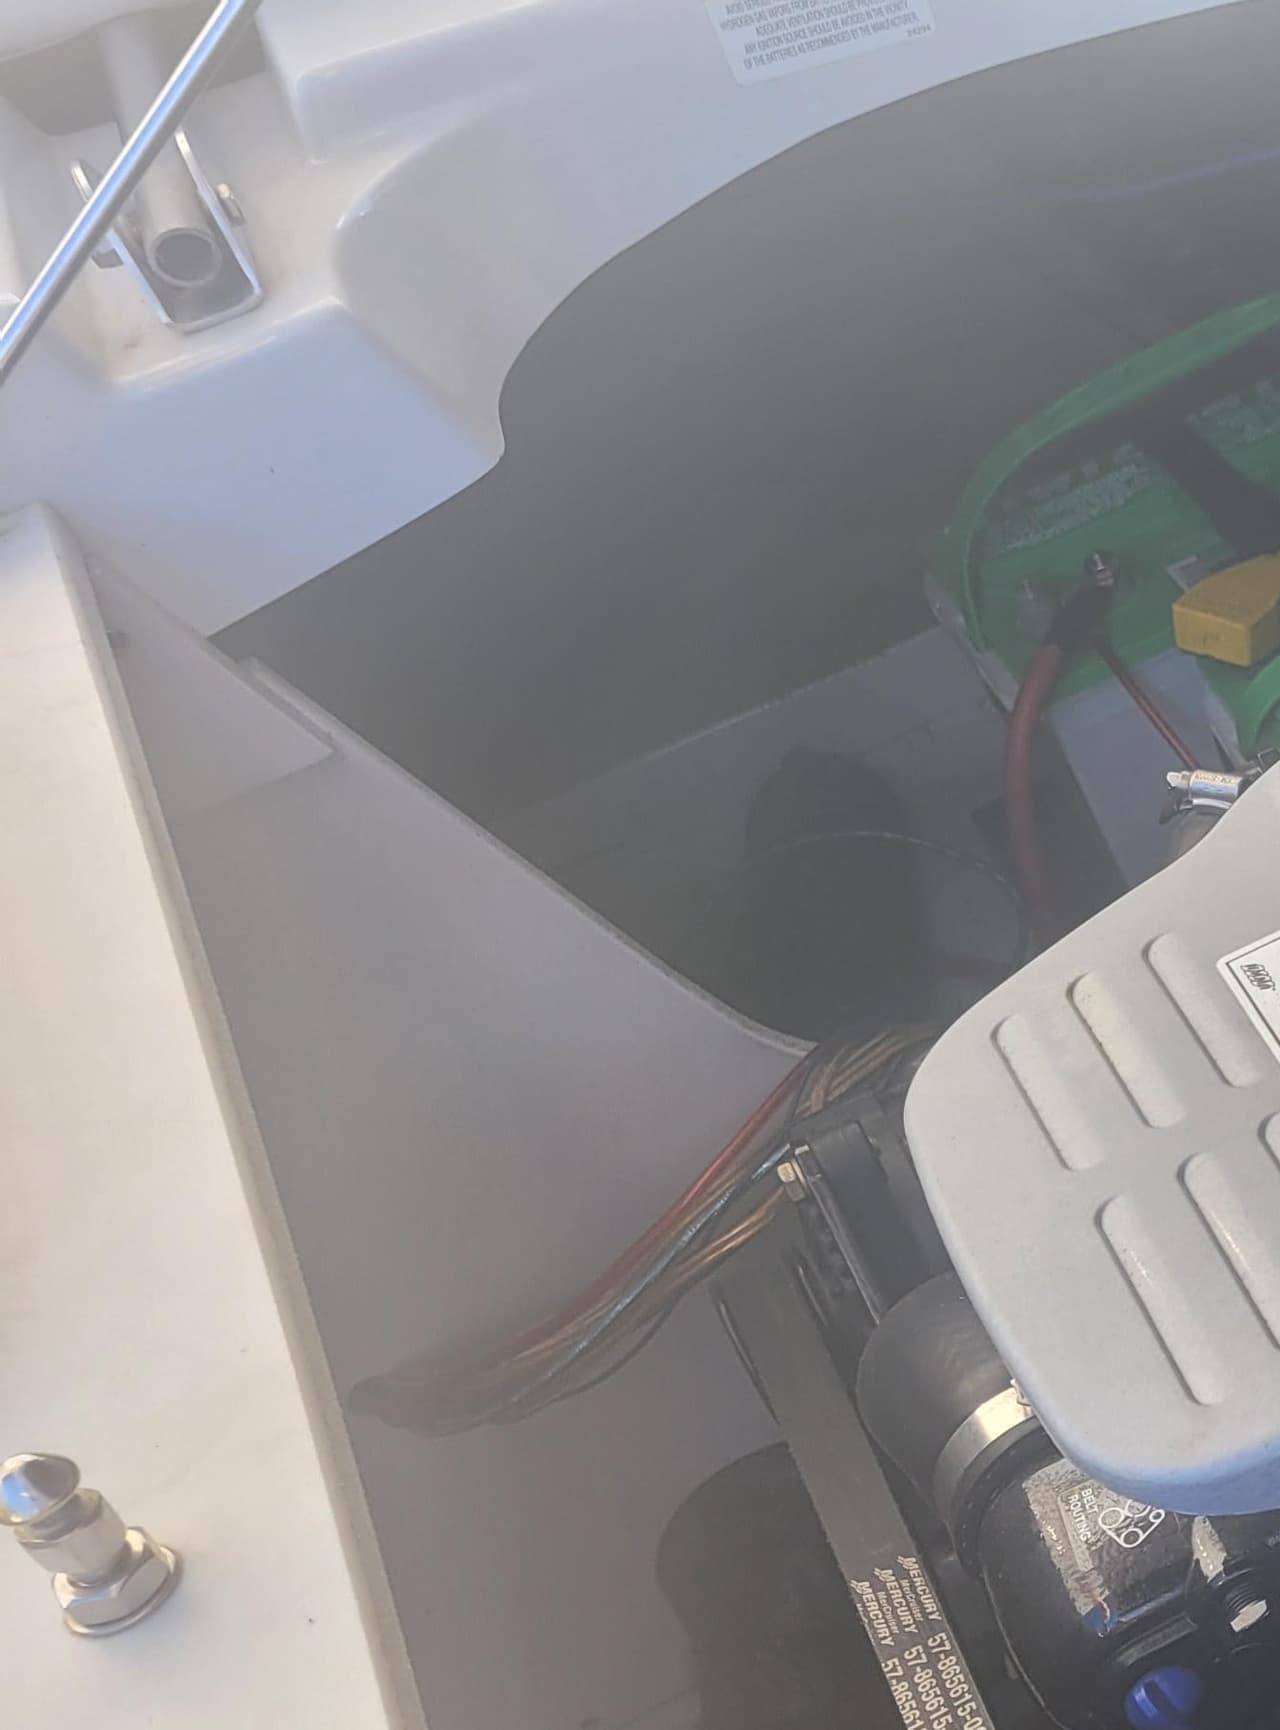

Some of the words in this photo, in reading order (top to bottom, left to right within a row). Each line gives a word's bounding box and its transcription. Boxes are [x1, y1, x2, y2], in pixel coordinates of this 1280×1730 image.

[1064, 1493, 1094, 1542] ROUTING
[1079, 1487, 1100, 1515] BELT
[873, 1568, 918, 1632] MERCURY
[876, 1591, 899, 1634] MerCruiser
[897, 1556, 942, 1620] MERCURY
[900, 1579, 924, 1621] MerCruiser
[850, 1580, 895, 1646] MERCURY
